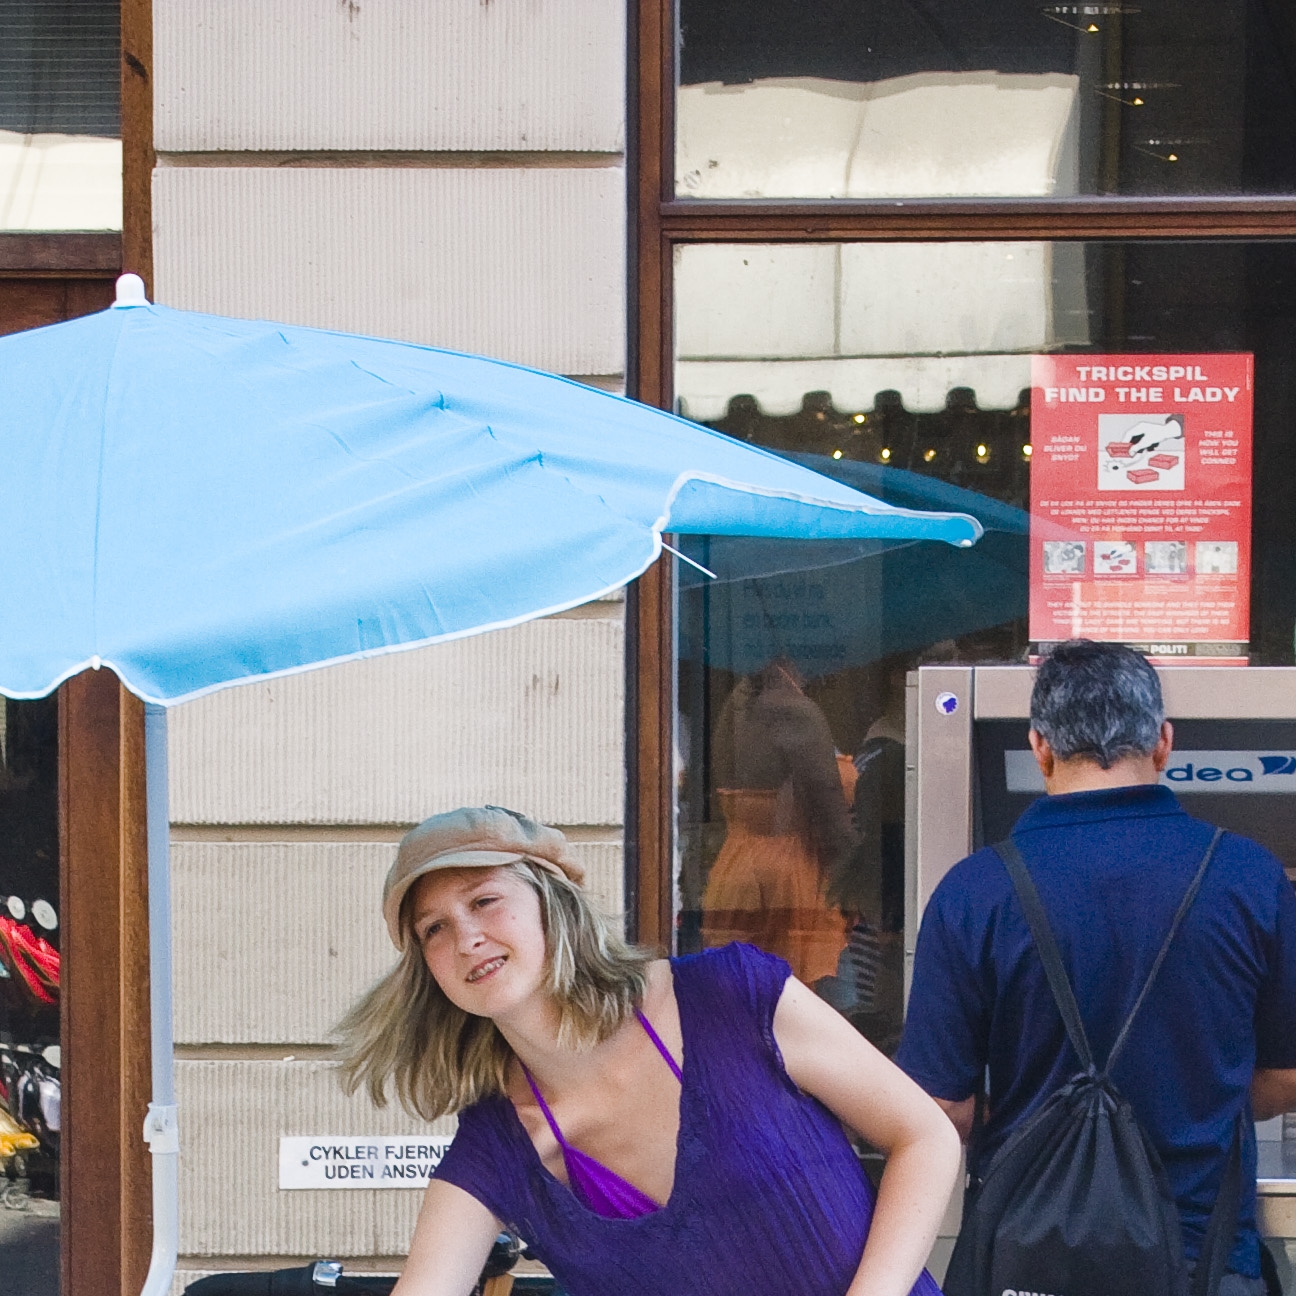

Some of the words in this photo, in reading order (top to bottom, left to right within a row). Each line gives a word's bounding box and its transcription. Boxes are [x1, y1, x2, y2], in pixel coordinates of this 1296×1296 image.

[1076, 366, 1208, 381] TRICKSPIL
[1044, 387, 1105, 402] FIND
[1115, 387, 1163, 402] THE
[1174, 387, 1239, 402] LADY
[1150, 645, 1187, 655] POLITI
[309, 1145, 379, 1161] CYKLER
[324, 1164, 374, 1180] UDEN
